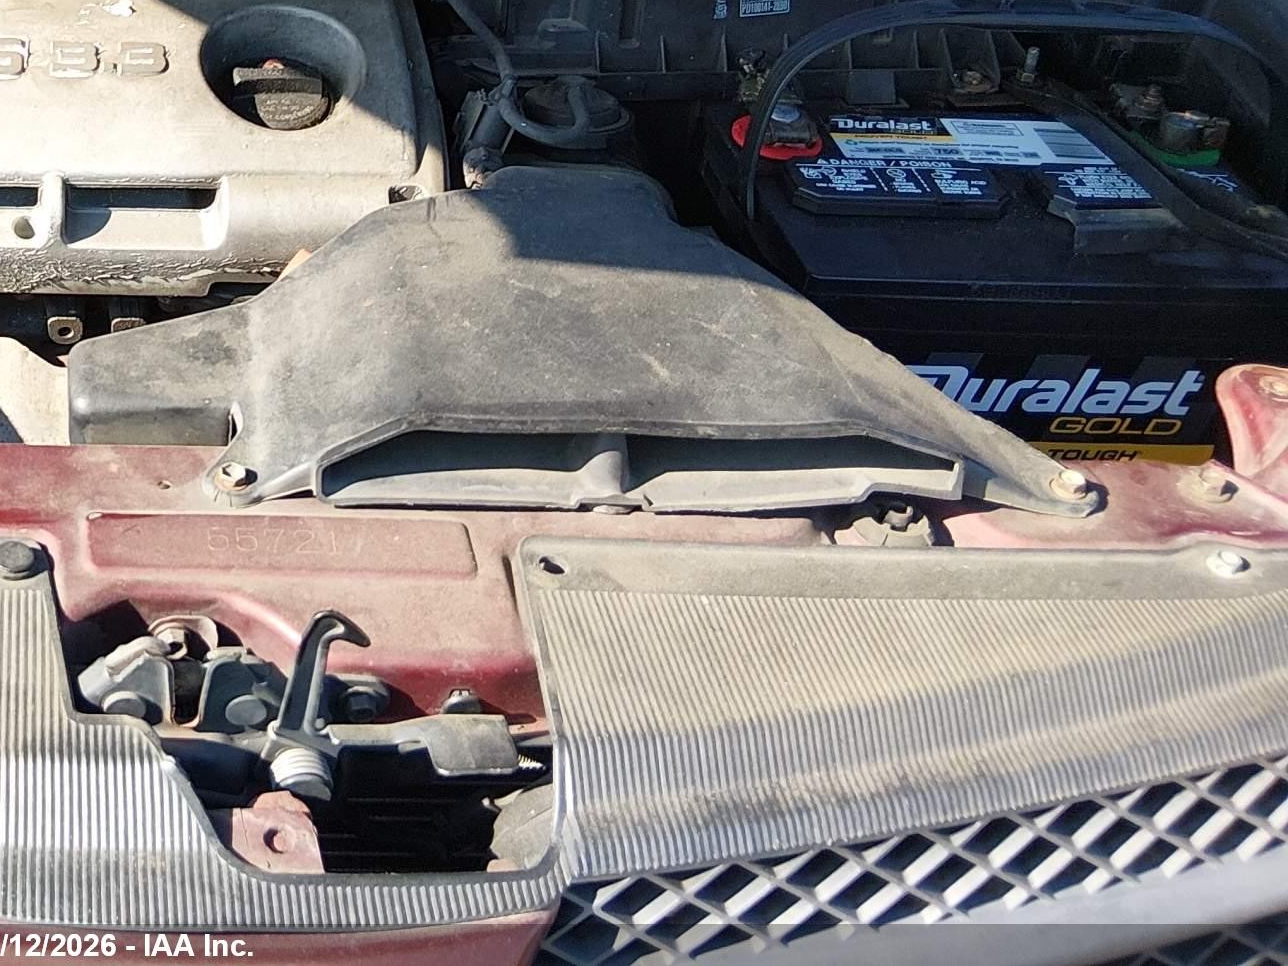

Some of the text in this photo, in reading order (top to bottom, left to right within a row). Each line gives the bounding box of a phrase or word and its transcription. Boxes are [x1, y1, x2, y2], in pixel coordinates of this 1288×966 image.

[48, 39, 170, 76] 3.3
[829, 117, 933, 131] Duralast
[830, 159, 887, 167] DANGER
[899, 160, 952, 168] POISON
[904, 364, 1204, 416] Duralast
[1048, 416, 1182, 435] GOLD
[1047, 449, 1138, 461] TOUGH
